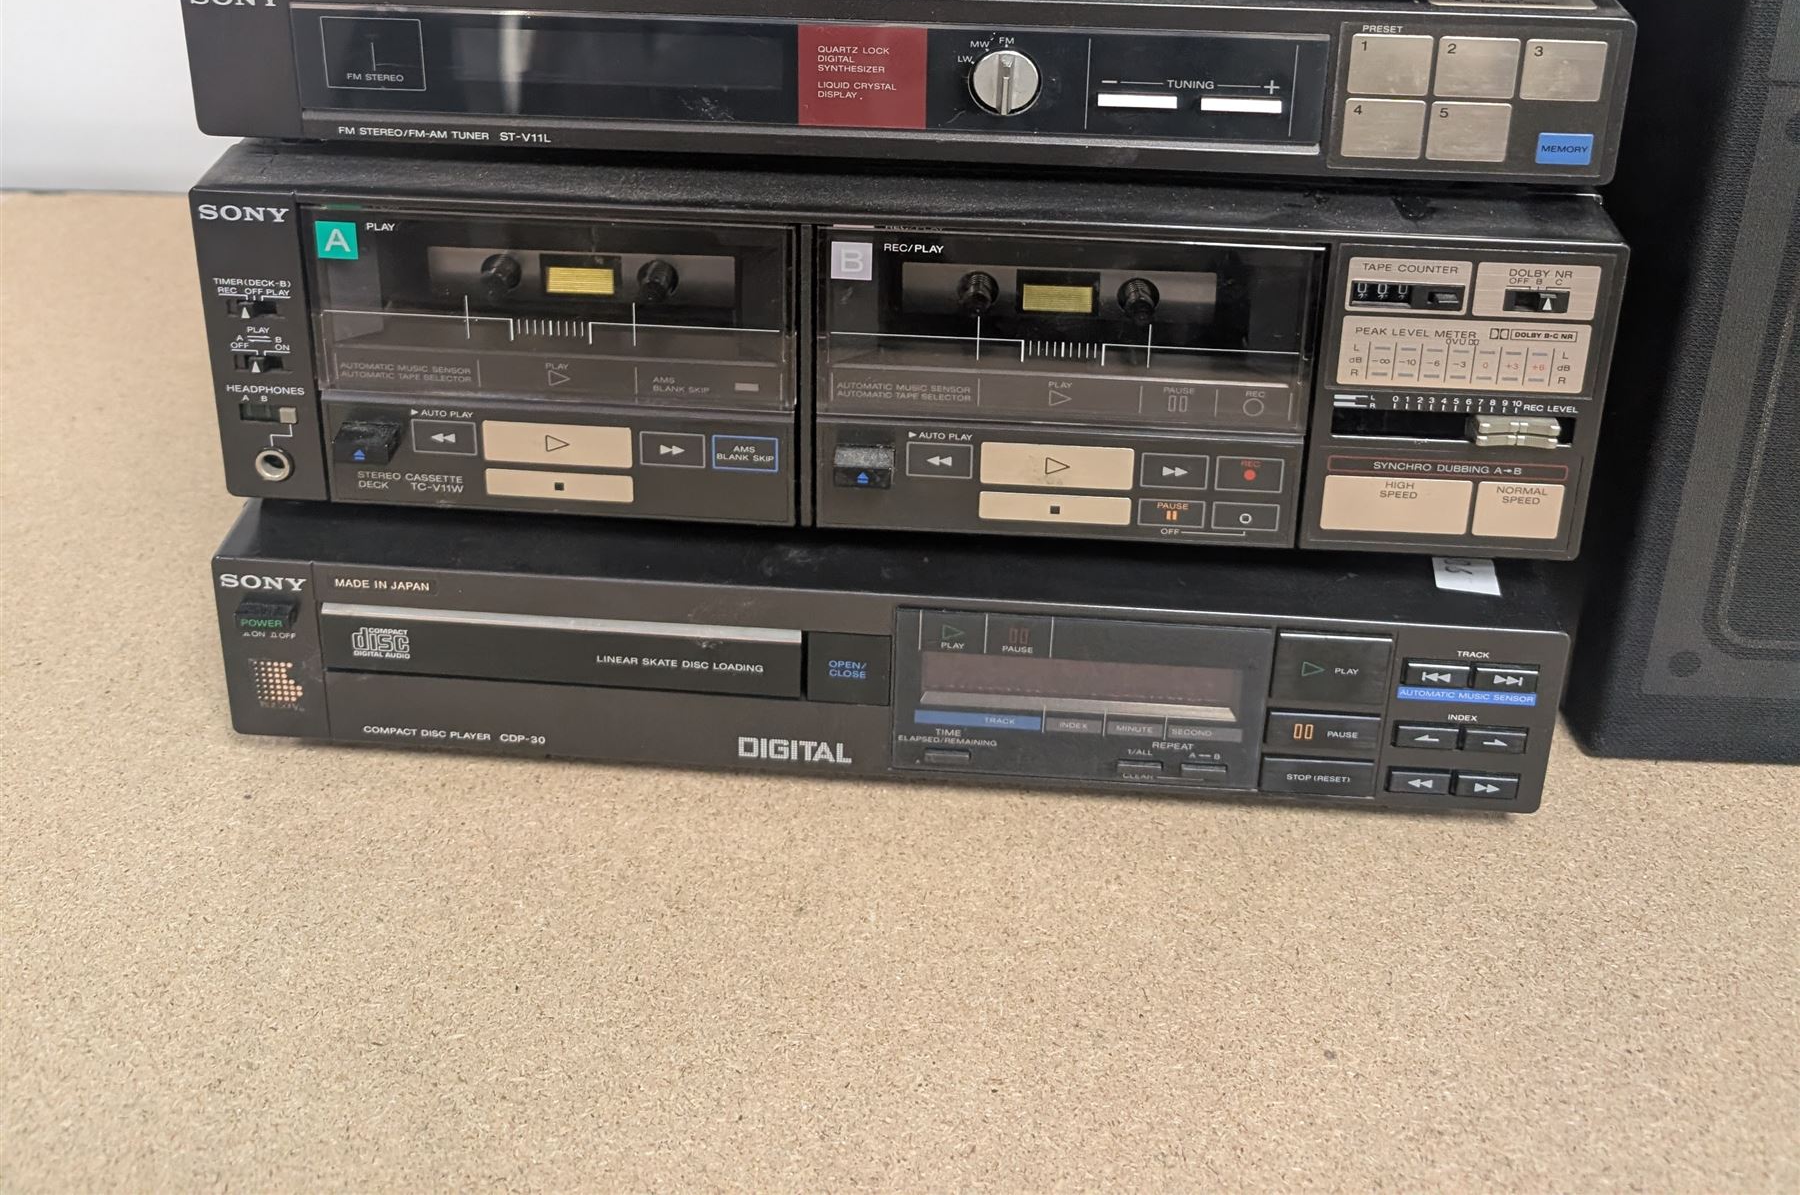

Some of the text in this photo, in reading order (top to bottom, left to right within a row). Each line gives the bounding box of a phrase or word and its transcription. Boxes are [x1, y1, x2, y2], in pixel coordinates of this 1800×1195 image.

[1362, 25, 1403, 34] PRESET
[817, 46, 890, 55] QUARTZ LOCK
[1447, 43, 1457, 55] 2
[1534, 46, 1544, 57] 3
[817, 55, 855, 63] DIGITAL
[817, 65, 885, 74] SYNTHESIZER
[347, 73, 404, 82] FM STEREO
[817, 82, 897, 92] LIQUID CRYSTAL
[1167, 80, 1215, 90] TUNING
[817, 90, 857, 99] DISPLAY
[1354, 105, 1363, 116] 4
[1439, 108, 1449, 119] 5
[338, 127, 551, 144] FM STEREO/FM-AM TUNER ST-V11L
[1541, 145, 1589, 155] MEMORY
[198, 205, 290, 223] SONY
[366, 223, 395, 232] PLAY
[884, 244, 944, 254] REC/PLAY
[1362, 263, 1458, 275] TAPE COUNTER
[1509, 268, 1573, 278] DOLBY NR
[1355, 327, 1477, 339] PEAK LEVEL METER
[545, 363, 569, 371] PLAY
[837, 381, 971, 394] AUTOMATIC MUSIC SENSOR
[1048, 381, 1073, 389] PLAY
[226, 385, 305, 395] HEADPHONES
[1163, 387, 1195, 395] PAUSE
[837, 390, 972, 401] AUTOMATIC TAPE SELECTOR
[421, 409, 447, 417] AUTO
[1524, 404, 1578, 413] REC LEVEL
[918, 431, 973, 442] AUTO PLAY
[733, 445, 756, 454] AMS
[716, 453, 774, 463] BLANK SKIP
[1373, 462, 1489, 474] SYNCHRO DUBBING
[357, 470, 464, 484] STEREO CASSETTE
[358, 480, 464, 493] DECK TC-V11W
[1385, 481, 1414, 490] HIGH
[1380, 490, 1417, 499] SPEED
[1496, 486, 1548, 495] NORMAL
[1502, 496, 1540, 505] SPEED
[1157, 502, 1189, 510] PAUSE
[220, 574, 306, 591] SONY
[335, 579, 430, 591] MADE IN JAPAN
[241, 619, 282, 628] POWER
[941, 642, 965, 650] PLAY
[1002, 645, 1033, 654] PAUSE
[1457, 650, 1489, 659] TRACK
[597, 655, 764, 673] LINEAR SKATE DISC LOADING
[828, 660, 867, 670] OPEN/
[829, 669, 866, 679] CLOSE
[1334, 667, 1359, 675] PLAY
[1401, 689, 1533, 703] AUTOMATIC MUSIC SENSOR
[1447, 714, 1477, 722] INDEX
[364, 725, 545, 745] COMPACT DISC PLAYER CDP-30
[935, 729, 961, 737] TIME
[1171, 728, 1212, 737] SECOND
[1327, 730, 1358, 739] PAUSE
[738, 736, 852, 764] DIGITAL
[1152, 741, 1194, 750] REPEAT
[1287, 774, 1350, 783] STOP (RESET)
